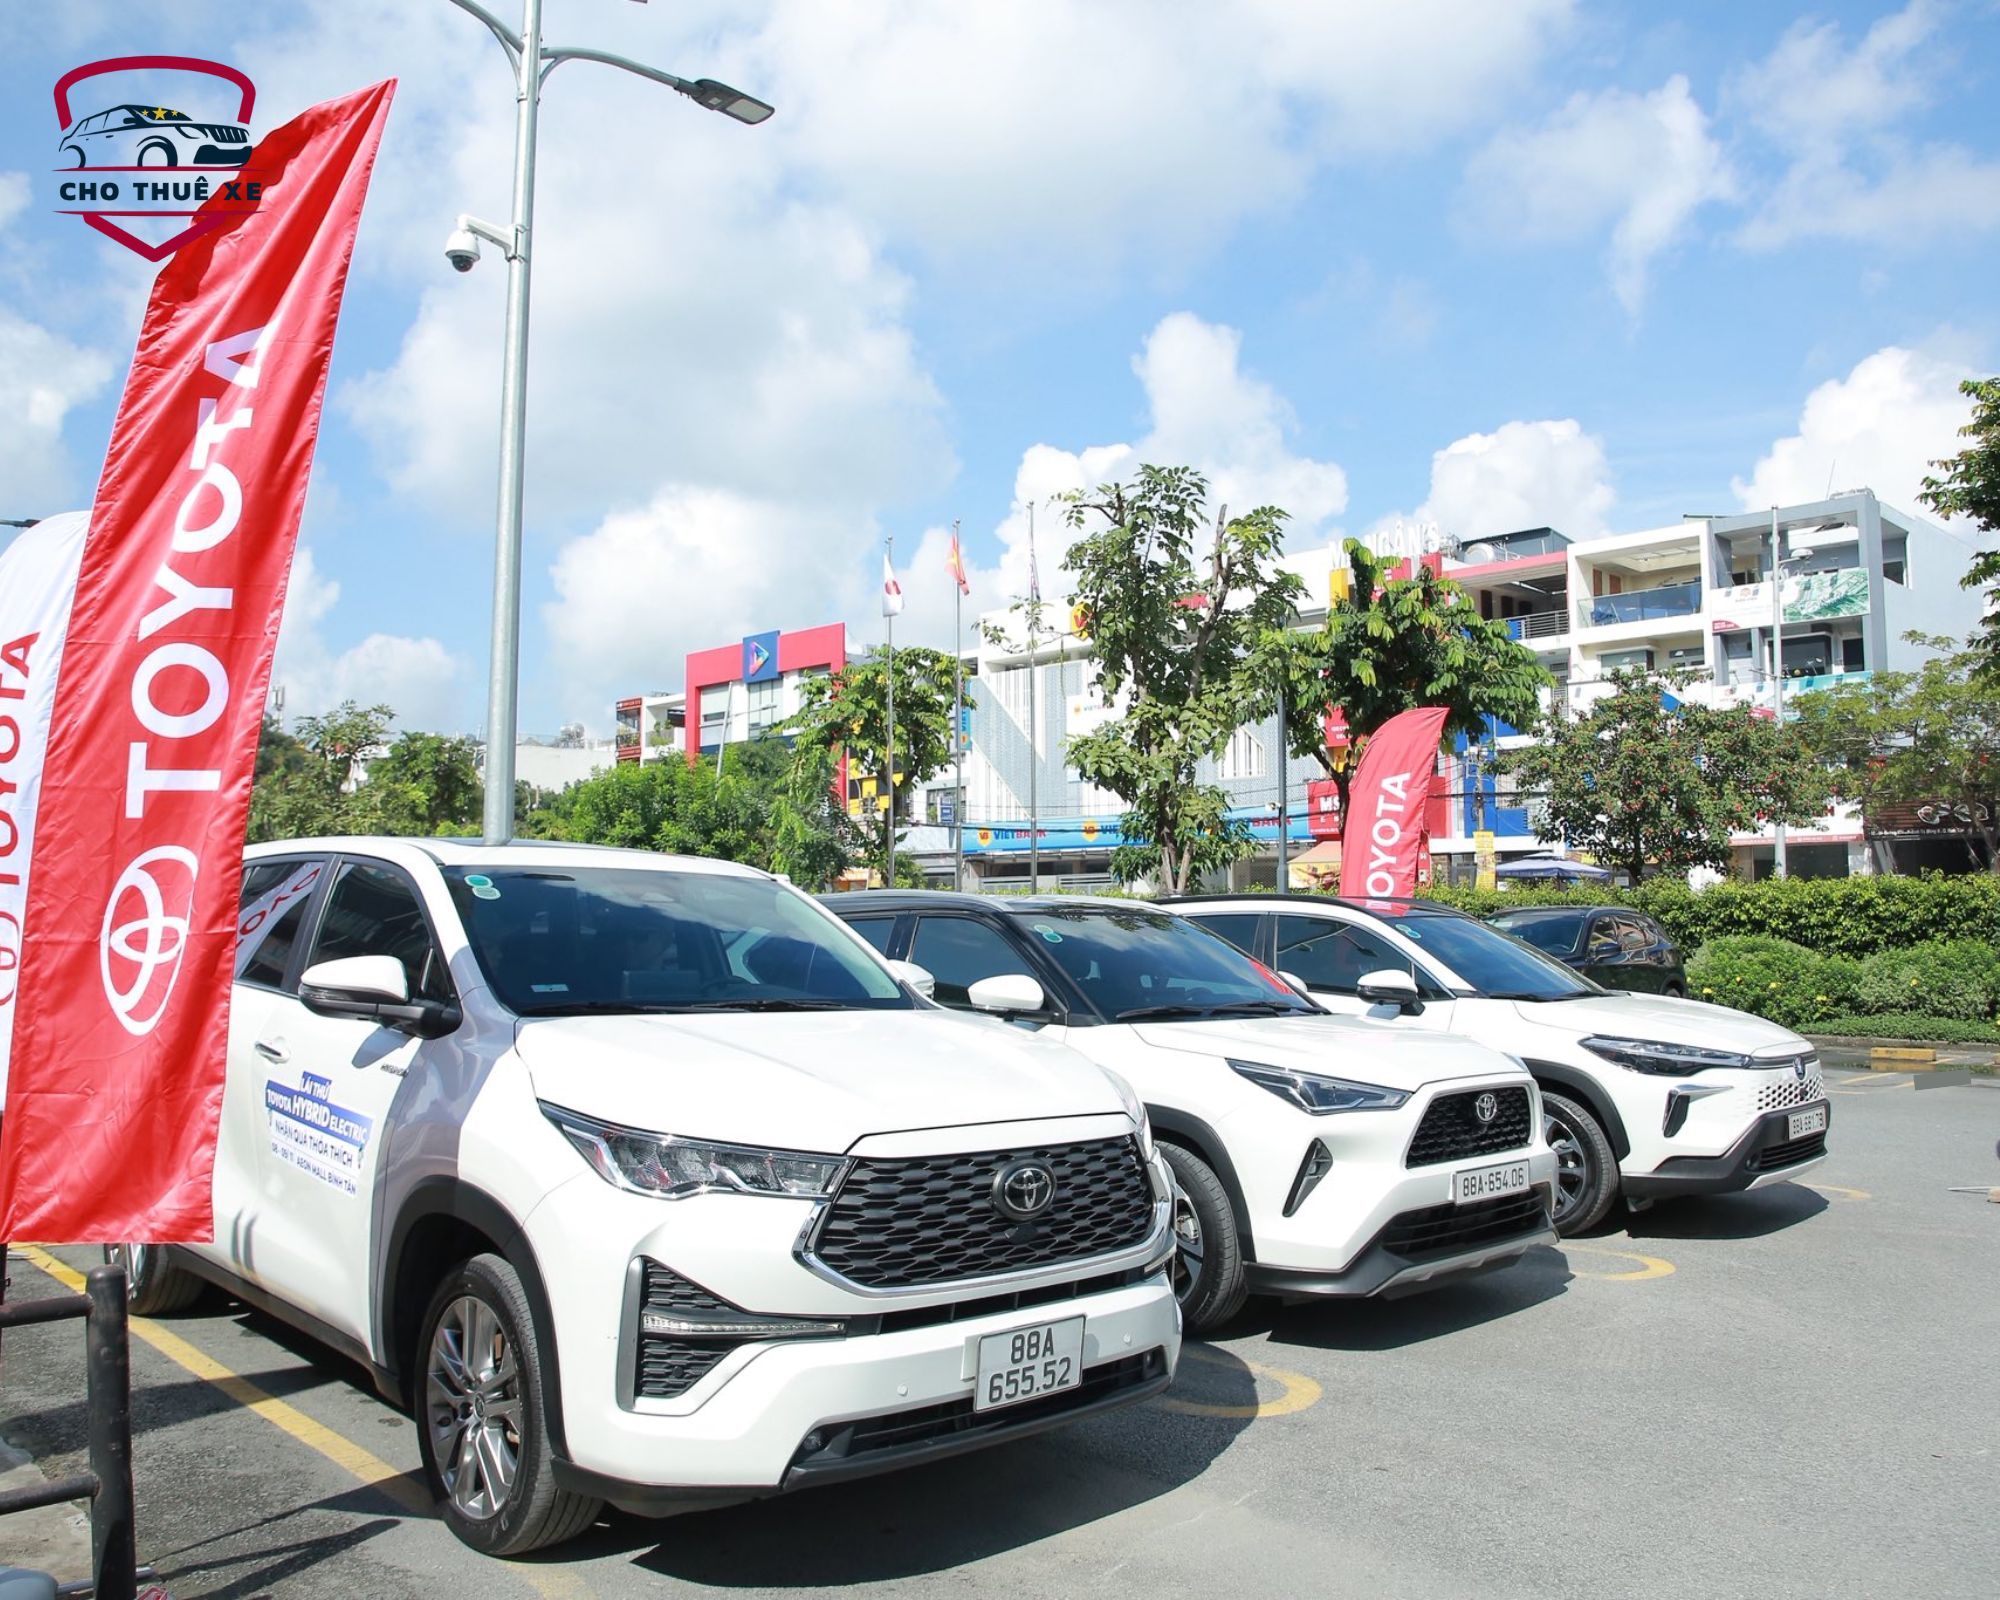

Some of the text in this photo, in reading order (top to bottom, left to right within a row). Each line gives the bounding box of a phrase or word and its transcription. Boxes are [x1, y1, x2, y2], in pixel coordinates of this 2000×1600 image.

[125, 319, 279, 819] TOYOTA
[993, 829, 1046, 841] VIETBAK
[1366, 771, 1411, 898] OYOTA
[267, 1089, 368, 1144] TOYOTA HYBRID ELECTRIC
[1011, 1327, 1054, 1364] 88A
[989, 1357, 1072, 1403] 655.52
